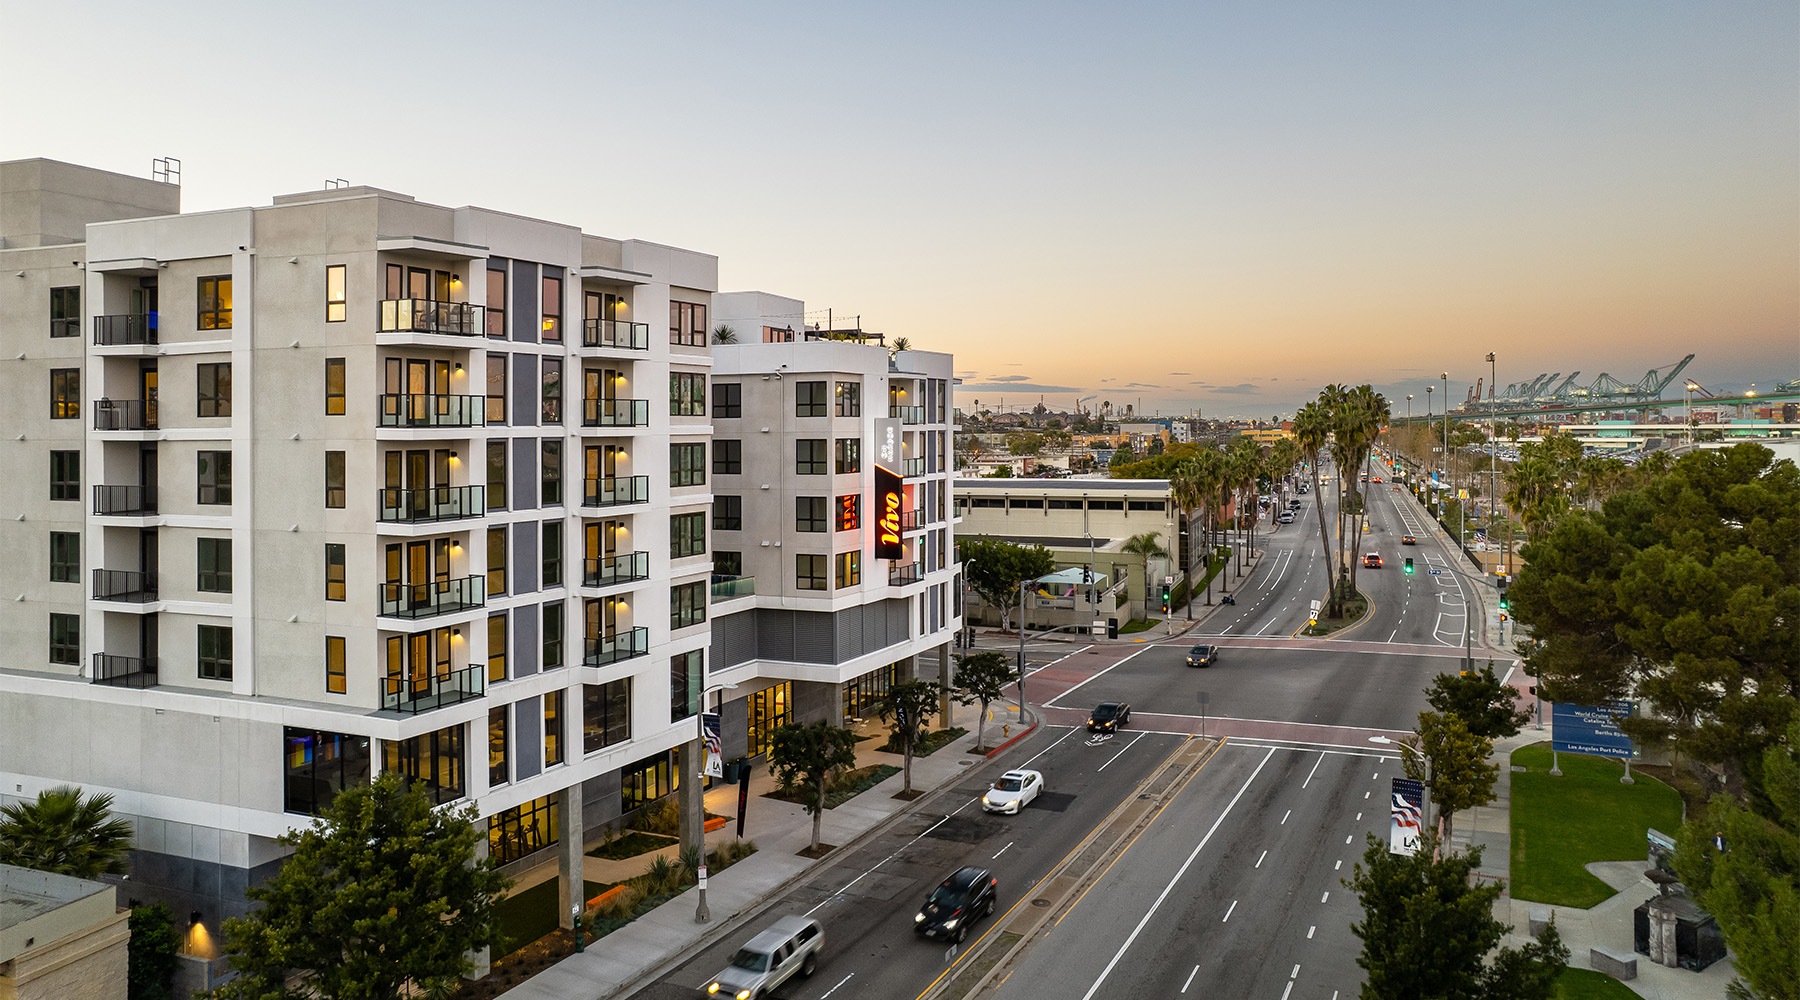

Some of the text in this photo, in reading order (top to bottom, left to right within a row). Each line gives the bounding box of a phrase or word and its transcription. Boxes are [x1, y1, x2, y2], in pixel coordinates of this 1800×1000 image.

[880, 492, 900, 545] Vivo
[713, 761, 721, 770] LA
[1404, 837, 1418, 848] LA
